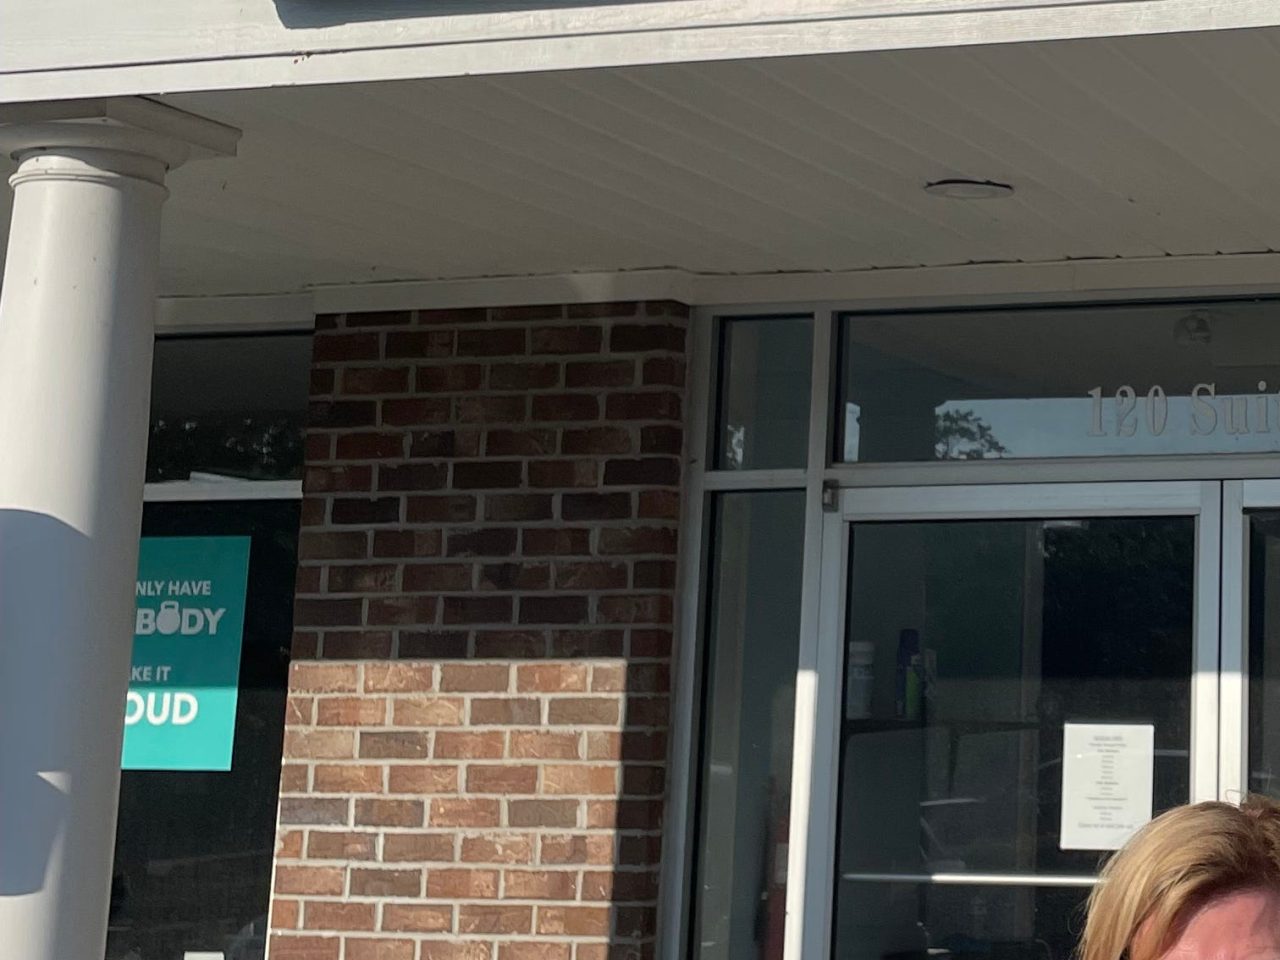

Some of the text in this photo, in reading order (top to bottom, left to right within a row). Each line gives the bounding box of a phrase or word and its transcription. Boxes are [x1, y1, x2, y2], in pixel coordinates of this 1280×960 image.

[1087, 384, 1168, 437] 120
[168, 580, 211, 596] HAVE
[130, 666, 172, 681] KE IT
